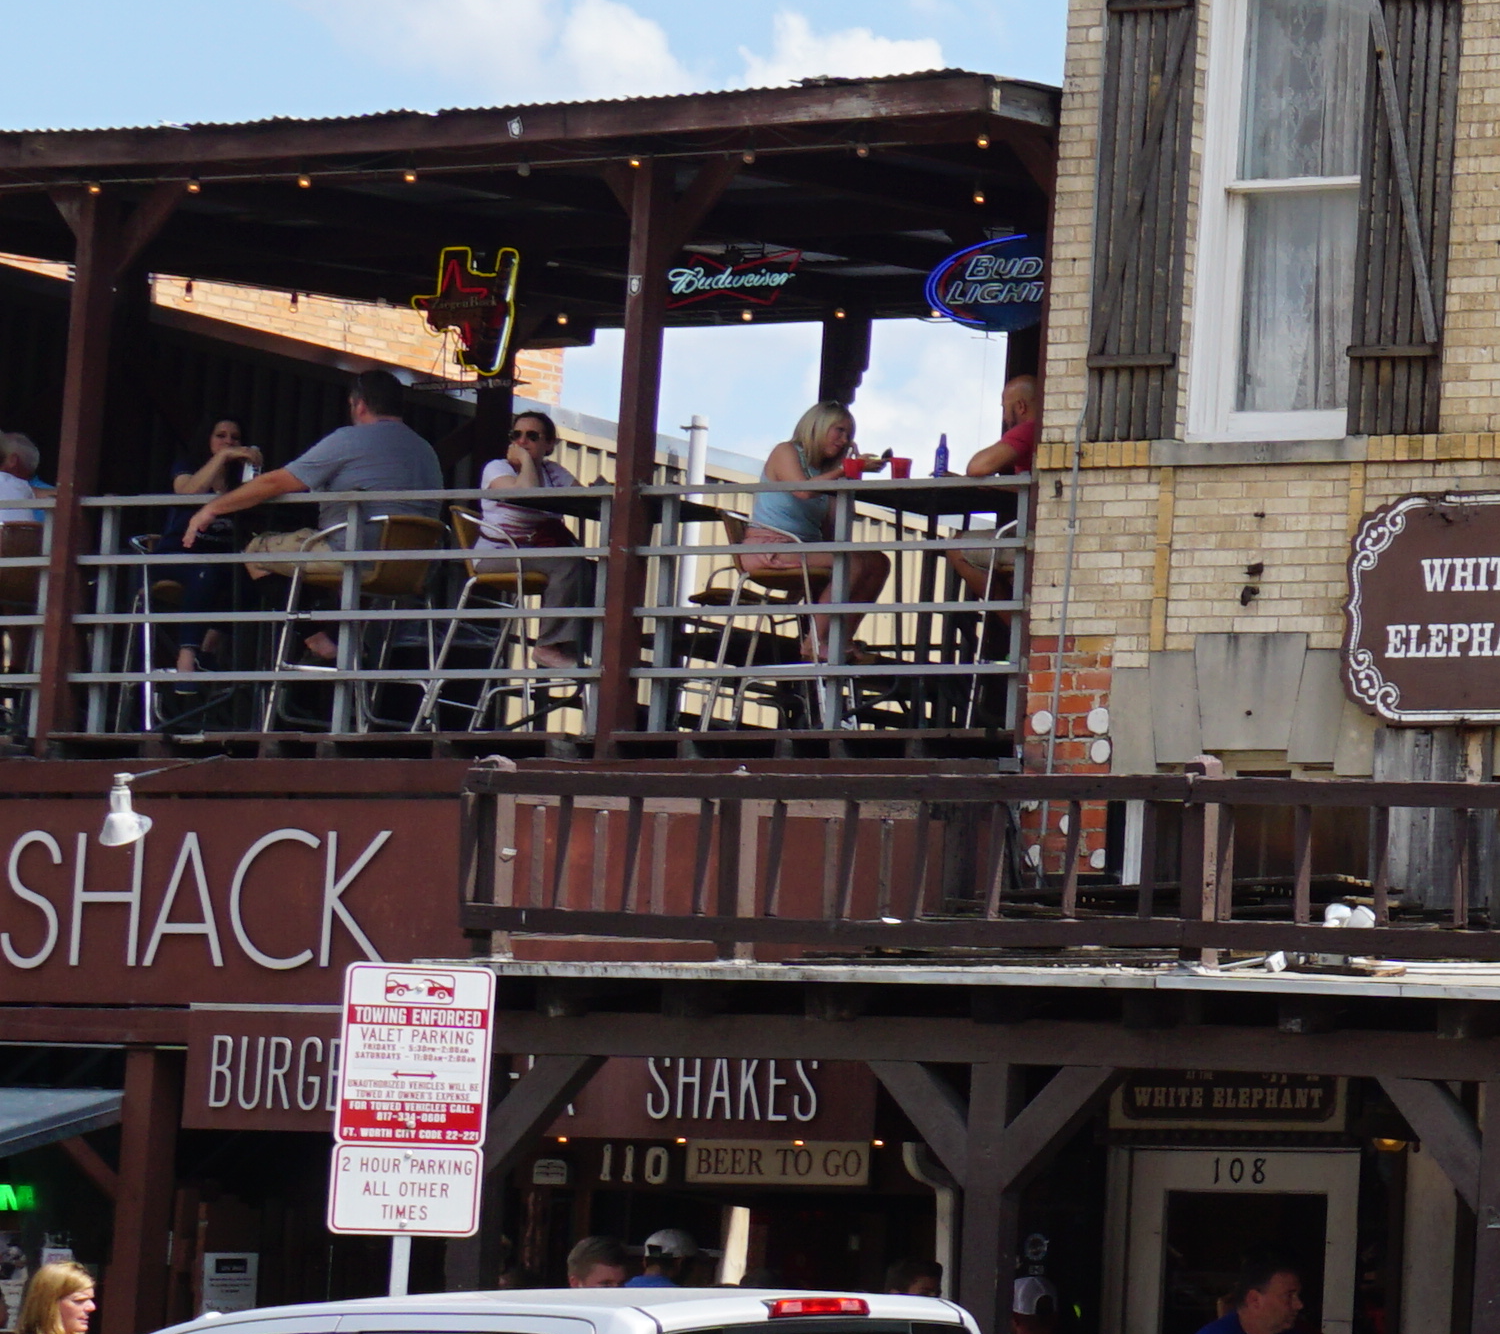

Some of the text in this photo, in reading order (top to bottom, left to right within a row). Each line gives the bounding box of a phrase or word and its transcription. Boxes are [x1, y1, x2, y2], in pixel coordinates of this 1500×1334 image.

[965, 255, 1043, 281] BUD
[668, 267, 796, 295] Budweiser
[0, 827, 392, 970] SHACK
[355, 1006, 482, 1027] TOWING ENFORCED
[360, 1027, 474, 1045] VALET PARKING
[355, 1051, 401, 1060] SATURDAYS
[363, 1043, 397, 1051] FRIDAYS
[208, 1034, 341, 1111] BURGE
[347, 1080, 479, 1092] UNAUTHORIZED VEHICLES WILL BE
[356, 1089, 470, 1101] TOWED AT OWNER'S EXPENSE
[646, 1057, 818, 1121] SHAKES
[349, 1100, 475, 1114] FOR TOWED VEHICLES CALL:
[1133, 1087, 1323, 1109] WHITE ELEPHANT
[342, 1127, 357, 1137] FT.
[360, 1128, 392, 1138] WORTH
[395, 1128, 416, 1139] CITY
[418, 1130, 443, 1140] CODE
[342, 1157, 473, 1176] 2 HOUR PARKING
[600, 1144, 669, 1184] 110
[696, 1147, 862, 1177] BEER TO GO
[1214, 1157, 1266, 1184] 108
[362, 1181, 449, 1198] ALL OTHER
[381, 1204, 428, 1221] TIMES
